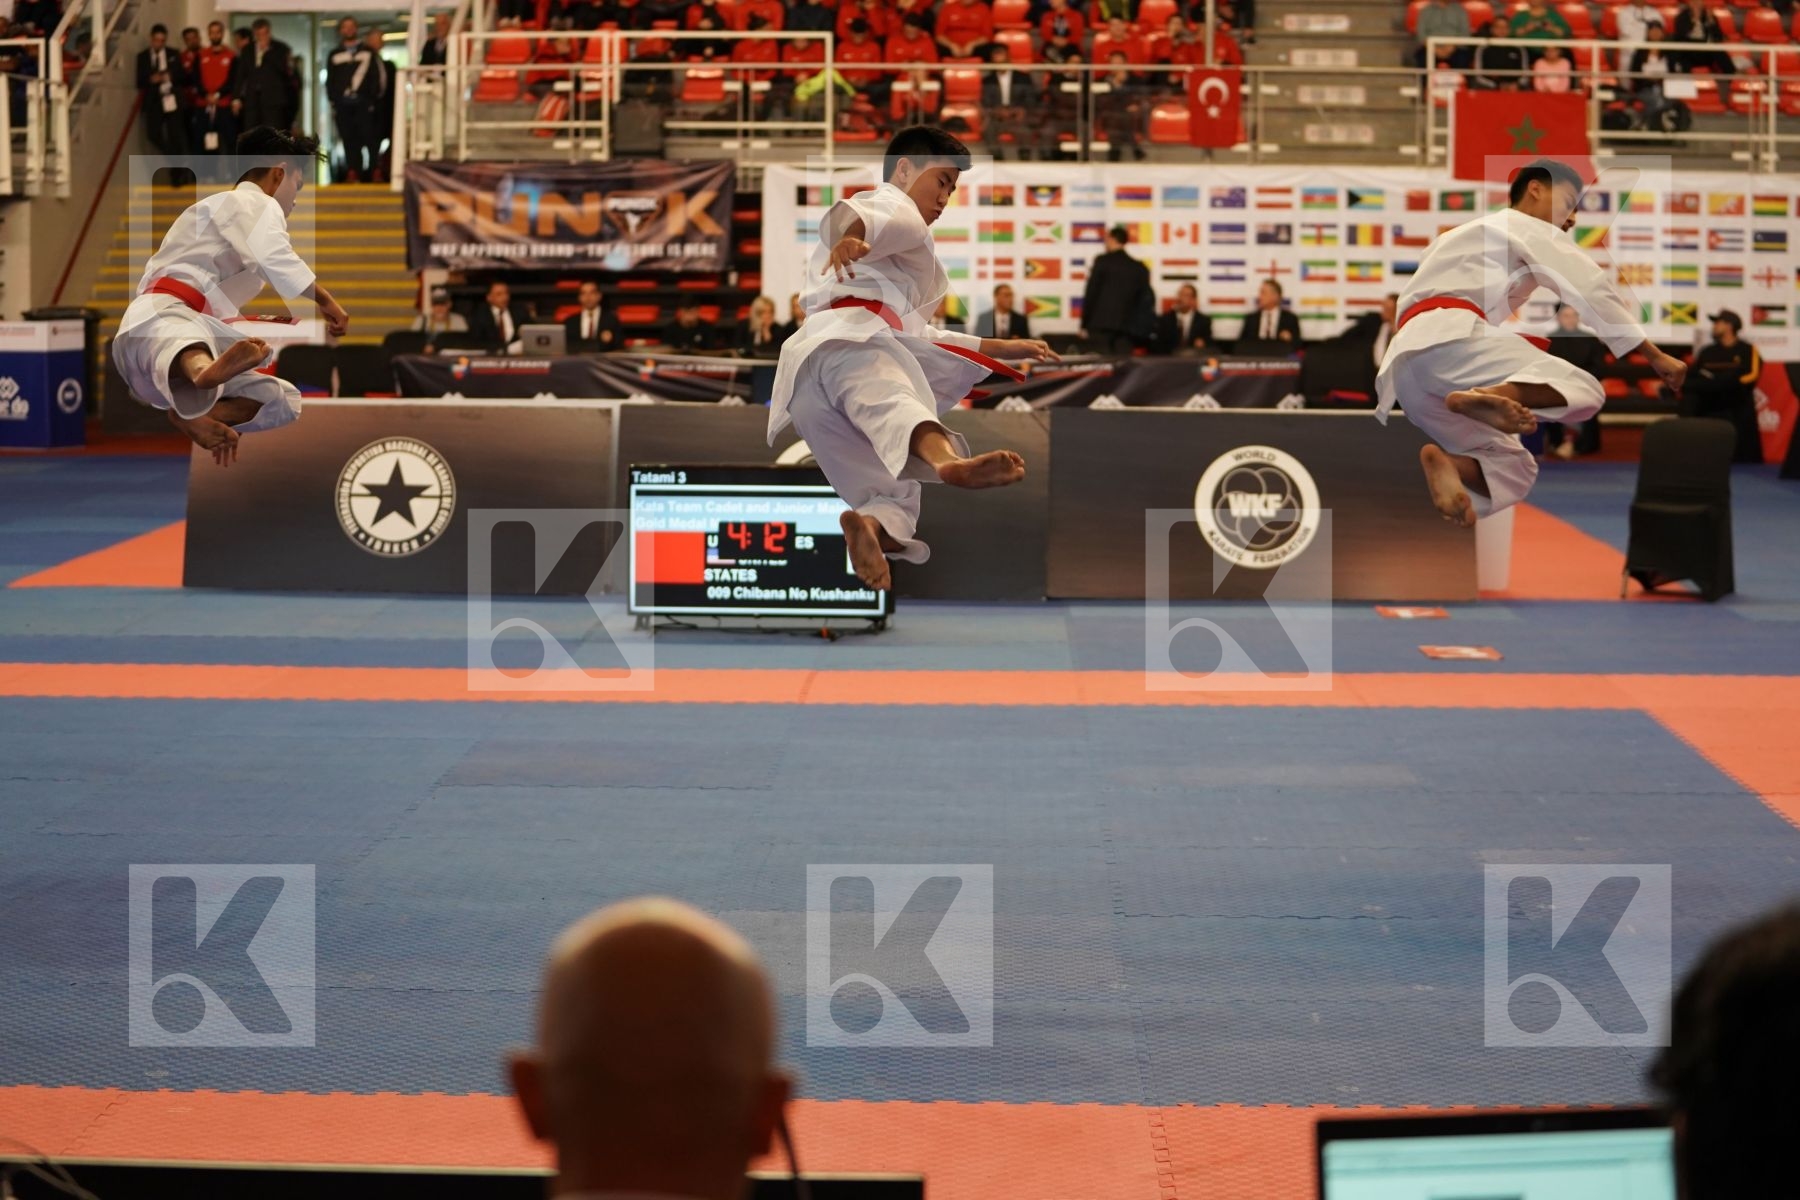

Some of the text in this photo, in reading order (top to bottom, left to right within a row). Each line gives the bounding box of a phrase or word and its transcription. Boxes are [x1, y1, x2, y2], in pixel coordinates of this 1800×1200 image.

[1233, 450, 1276, 462] WORLD
[632, 471, 687, 484] Tatami 3
[635, 500, 665, 513] Kata
[668, 500, 703, 513] Team
[705, 501, 743, 513] Cadet
[745, 501, 770, 513] and
[774, 502, 815, 513] Junior
[1227, 493, 1283, 518] WKF
[636, 517, 665, 530] Gold
[668, 517, 704, 531] Medal
[703, 568, 758, 583] STATES
[706, 586, 876, 602] 009 Chibana No Kushanku
